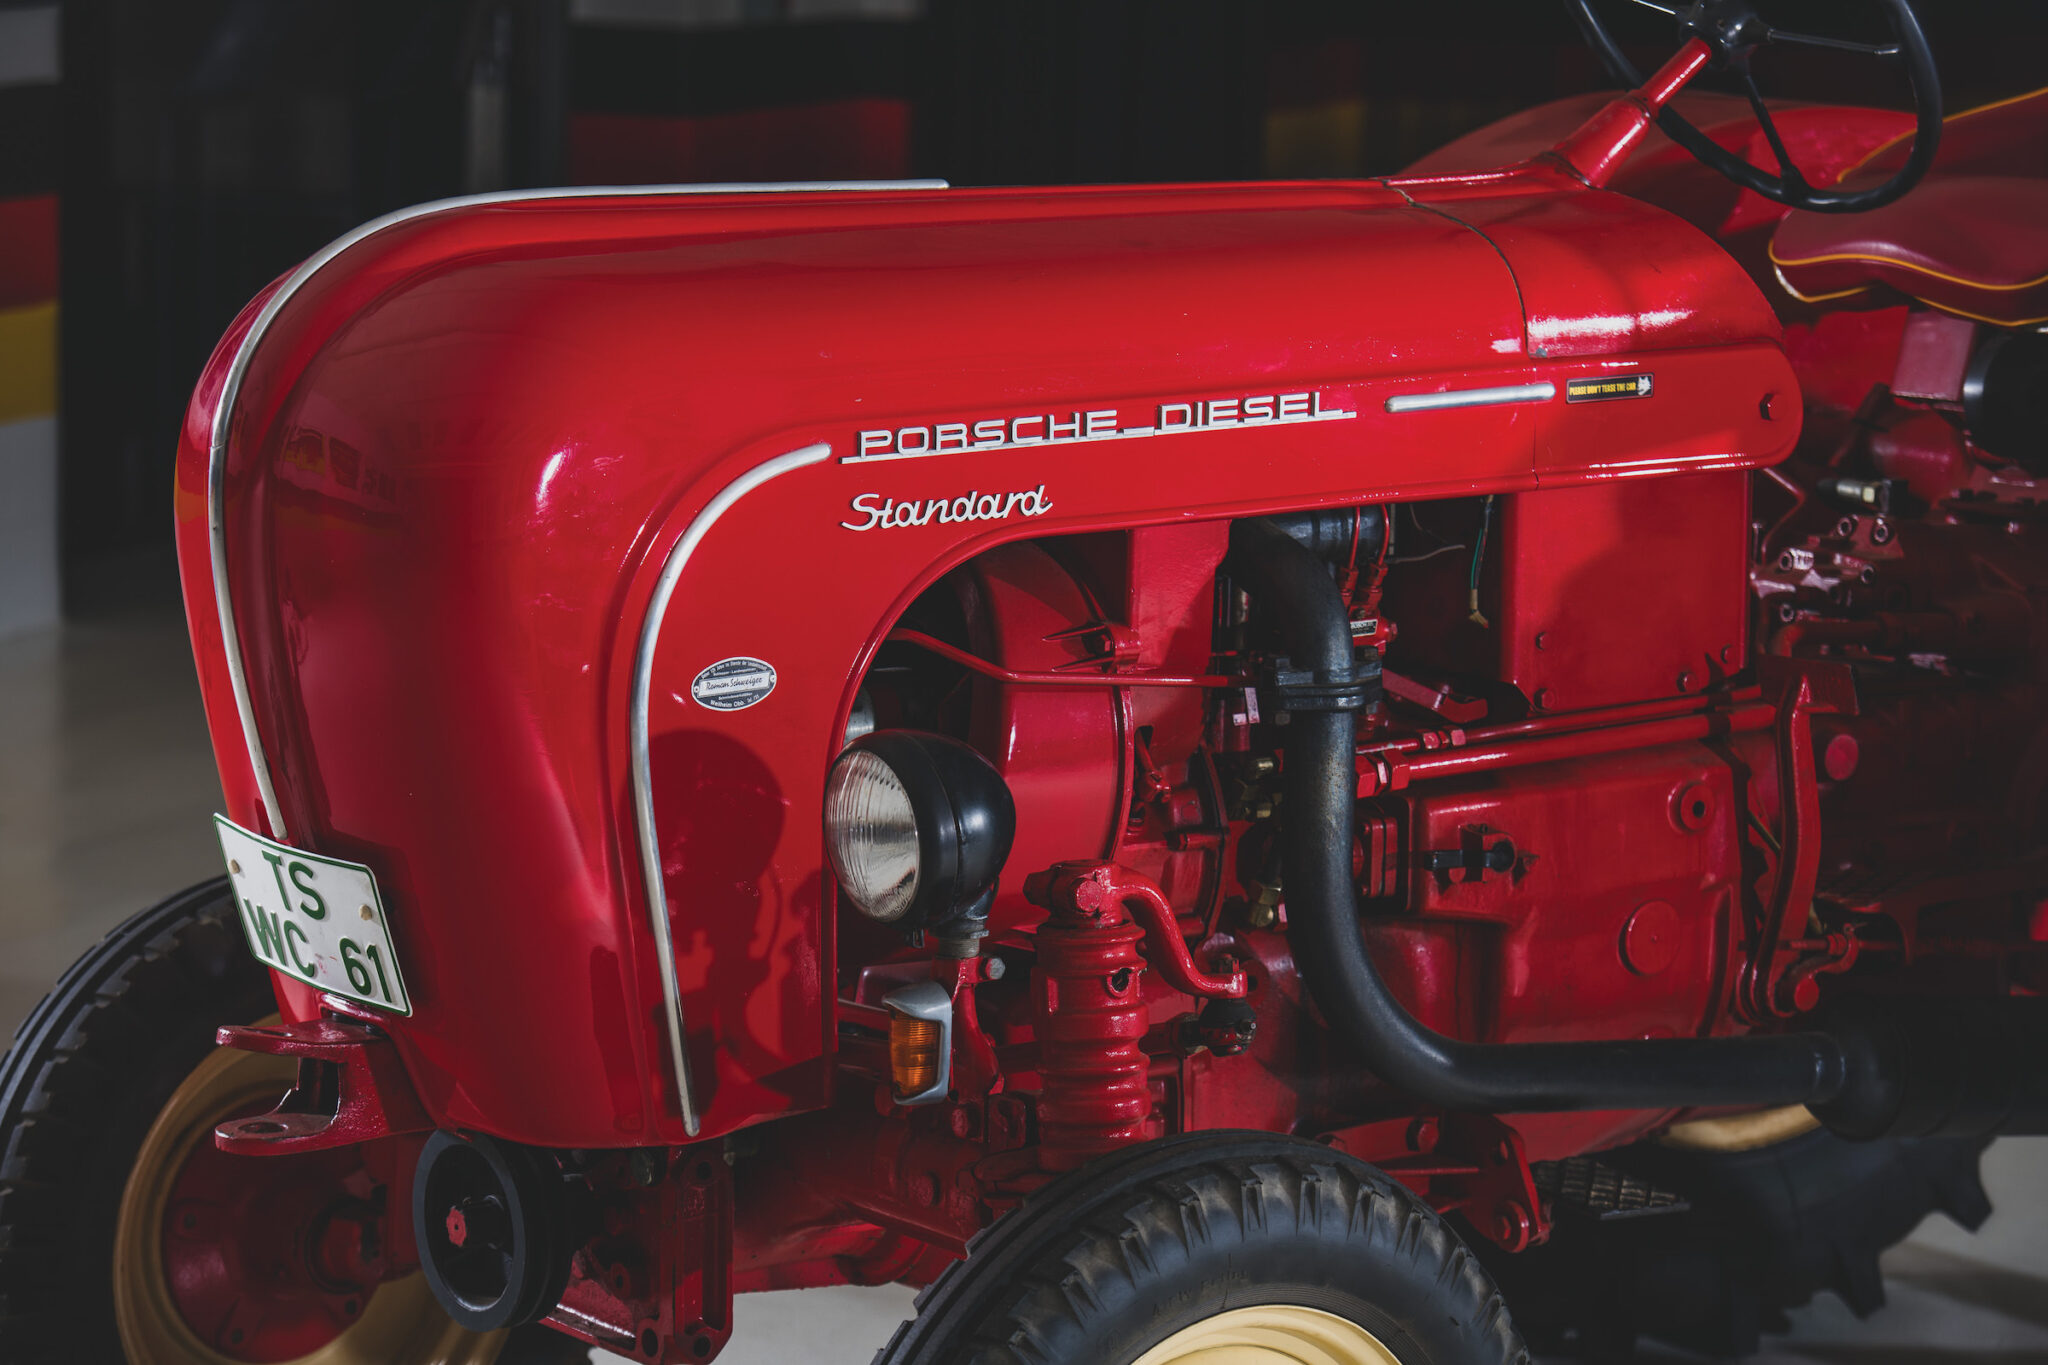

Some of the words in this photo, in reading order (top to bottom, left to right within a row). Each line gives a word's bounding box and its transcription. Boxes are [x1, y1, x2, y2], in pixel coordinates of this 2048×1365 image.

[1569, 386, 1586, 396] PLEASE
[1587, 384, 1600, 394] DON'T
[1602, 383, 1616, 393] TEASE
[1617, 382, 1625, 392] THE
[858, 408, 1119, 460] PORSCHE
[1158, 390, 1346, 433] DIESEL
[842, 485, 1053, 532] Standard
[705, 681, 729, 690] Roman
[261, 850, 325, 920] TS
[243, 898, 315, 978] WC
[339, 937, 392, 1003] 61
